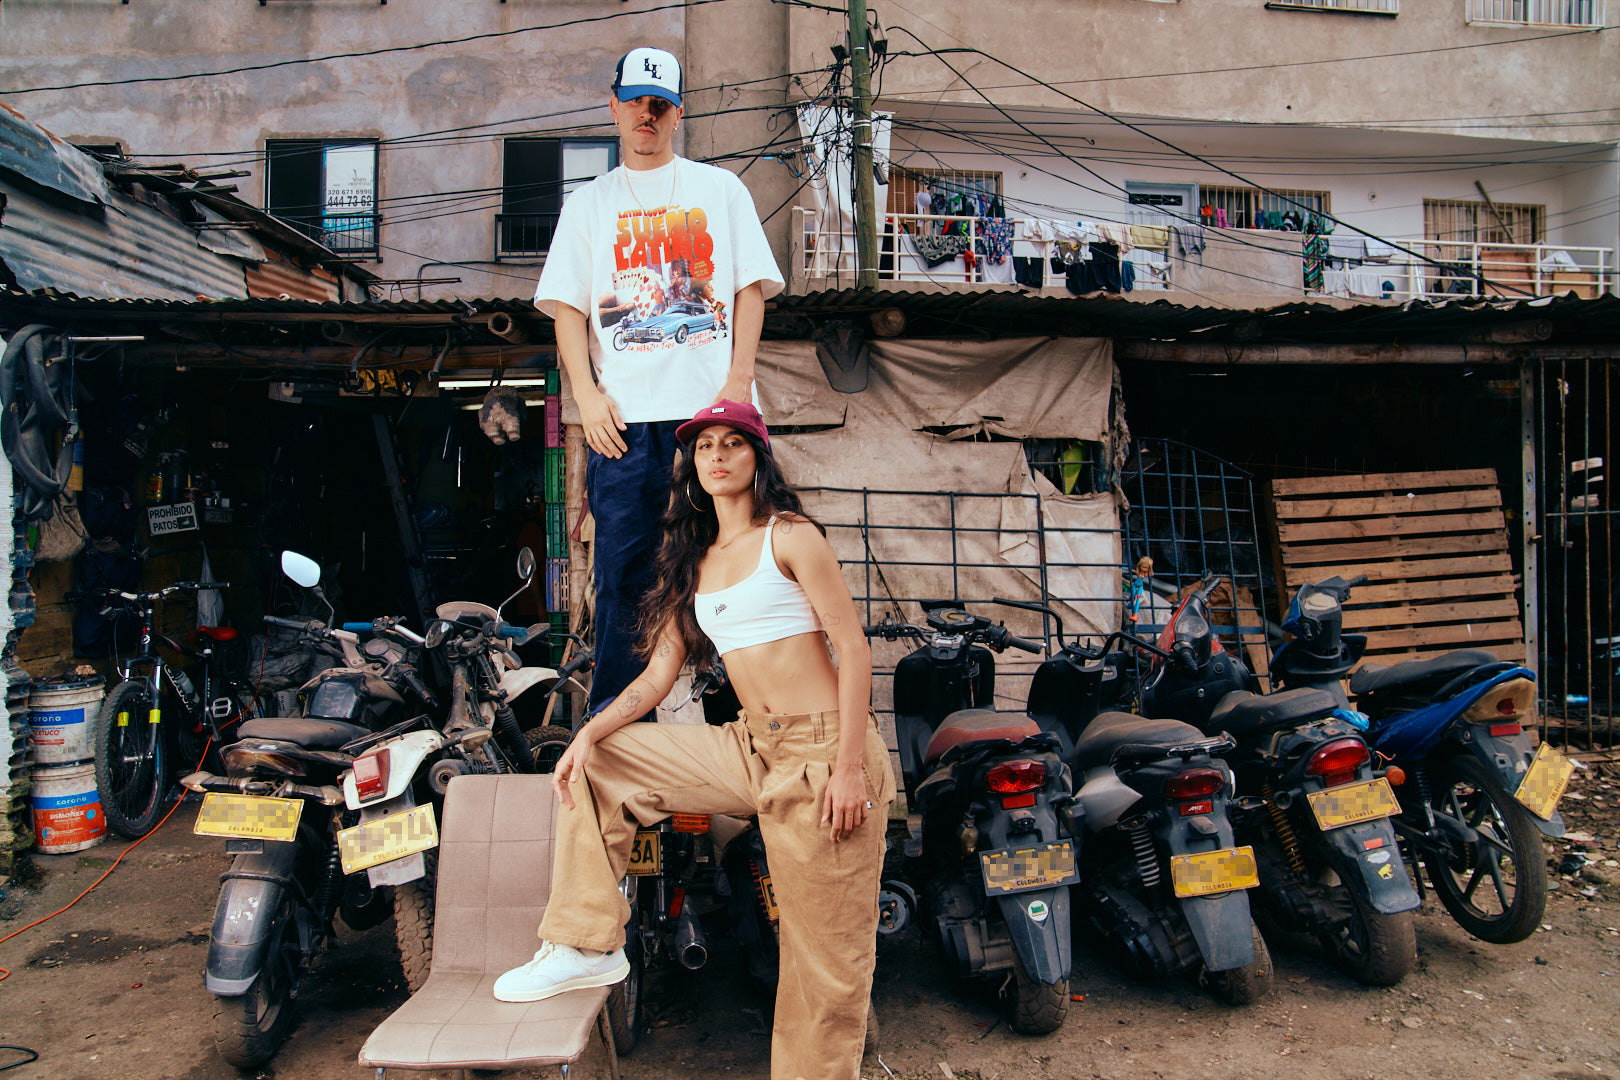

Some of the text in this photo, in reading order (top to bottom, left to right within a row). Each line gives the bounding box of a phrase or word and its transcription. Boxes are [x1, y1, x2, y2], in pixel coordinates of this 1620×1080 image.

[328, 195, 372, 207] 444 73 62
[616, 205, 708, 248] SUEÑO
[613, 231, 714, 272] LATINO
[149, 505, 192, 519] PROHIBIDO
[153, 520, 178, 531] PATOS
[57, 797, 87, 805] corona
[1016, 877, 1047, 886] COLOMBIA
